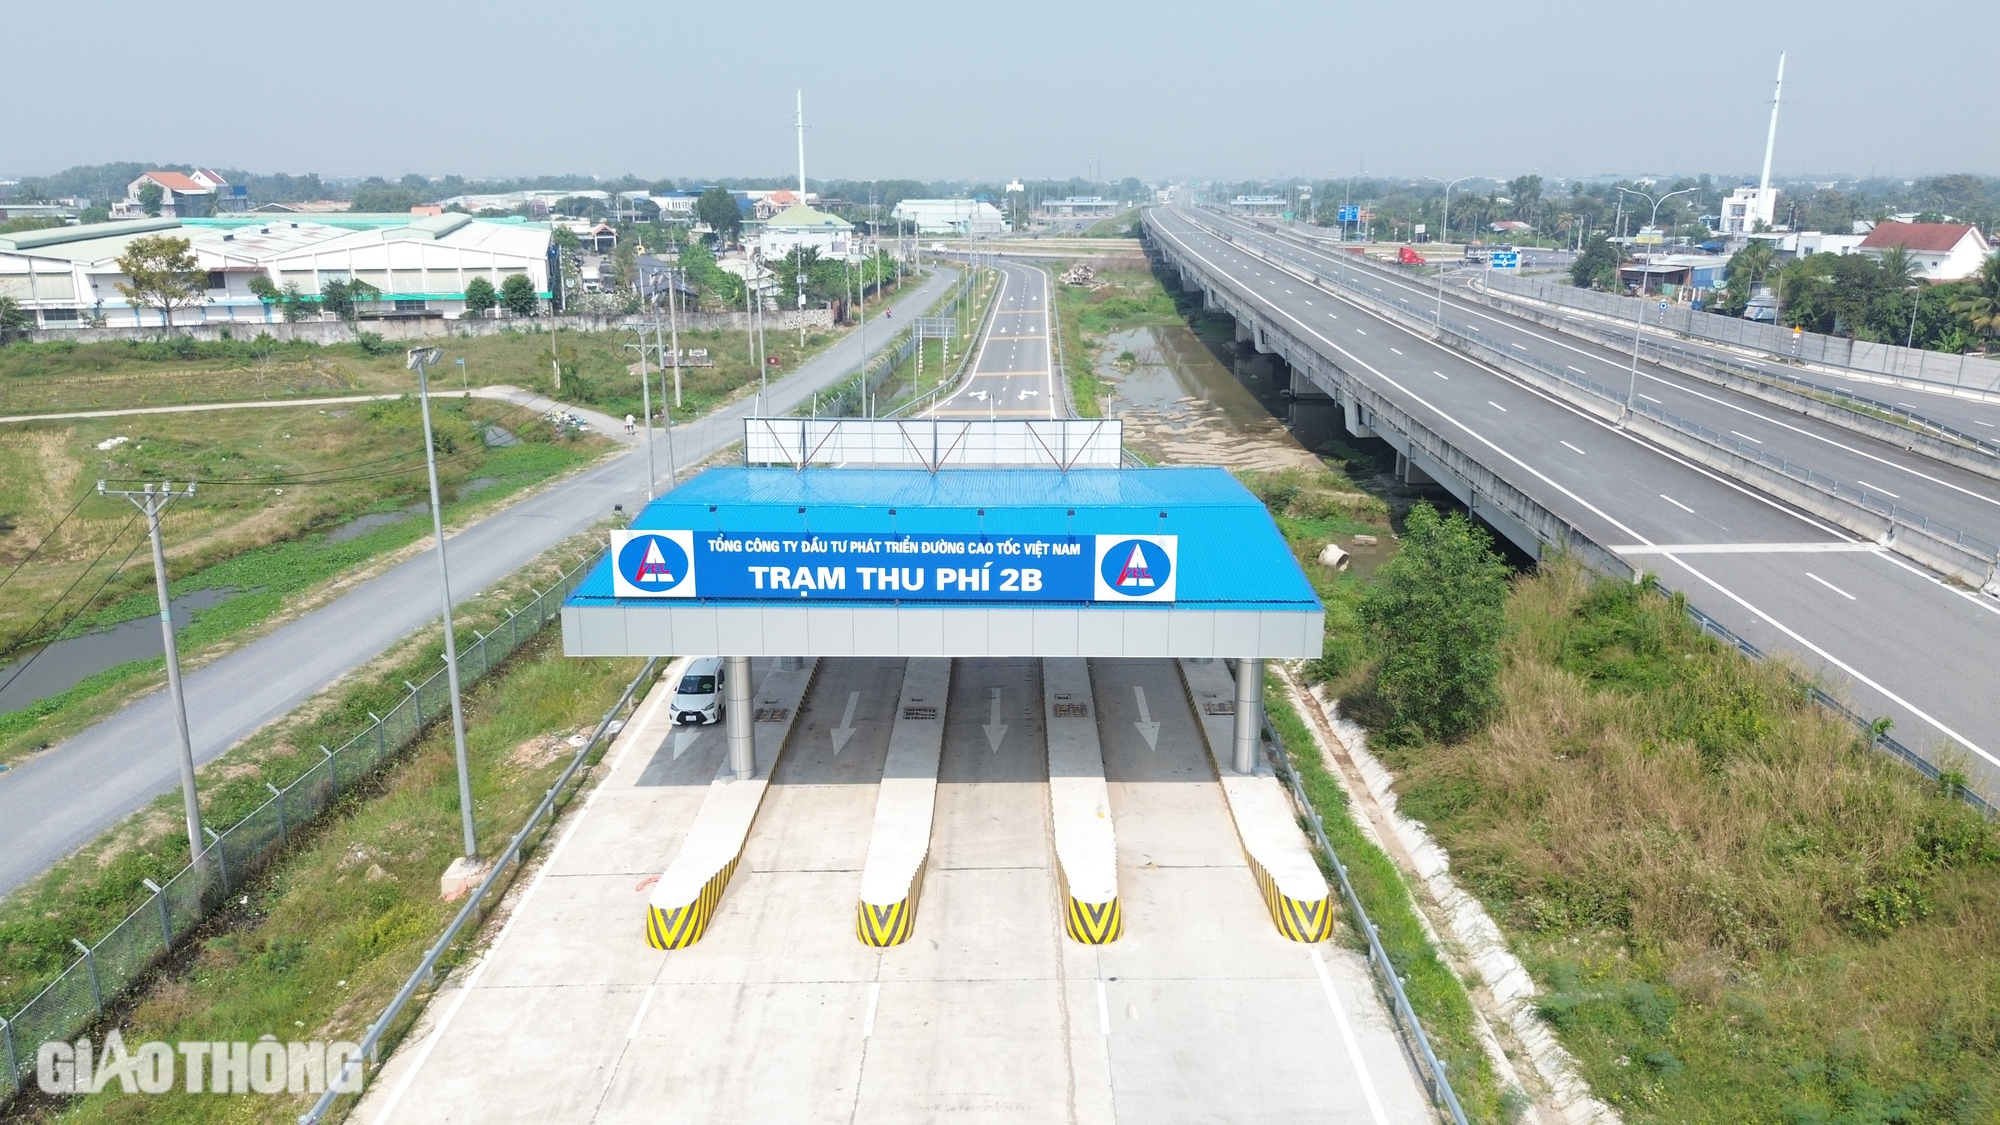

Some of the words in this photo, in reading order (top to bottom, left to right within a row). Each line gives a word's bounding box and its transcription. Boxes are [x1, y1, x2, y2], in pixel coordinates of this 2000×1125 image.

[708, 533, 742, 553] TỔNG
[745, 537, 779, 553] CÔNG
[782, 540, 798, 553] TY
[801, 535, 828, 553] ĐẦU
[831, 540, 848, 553] TƯ
[850, 538, 882, 553] PHÁT
[885, 534, 918, 554] TRIỂN
[921, 538, 965, 554] ĐƯỜNG
[968, 542, 994, 555] CAO
[996, 538, 1021, 555] TỐC
[1024, 540, 1050, 559] VIỆT
[1052, 543, 1081, 556] NAM
[748, 566, 846, 597] TRẠM
[856, 567, 925, 591] THU
[936, 561, 994, 592] PHÍ
[999, 568, 1043, 592] 2B
